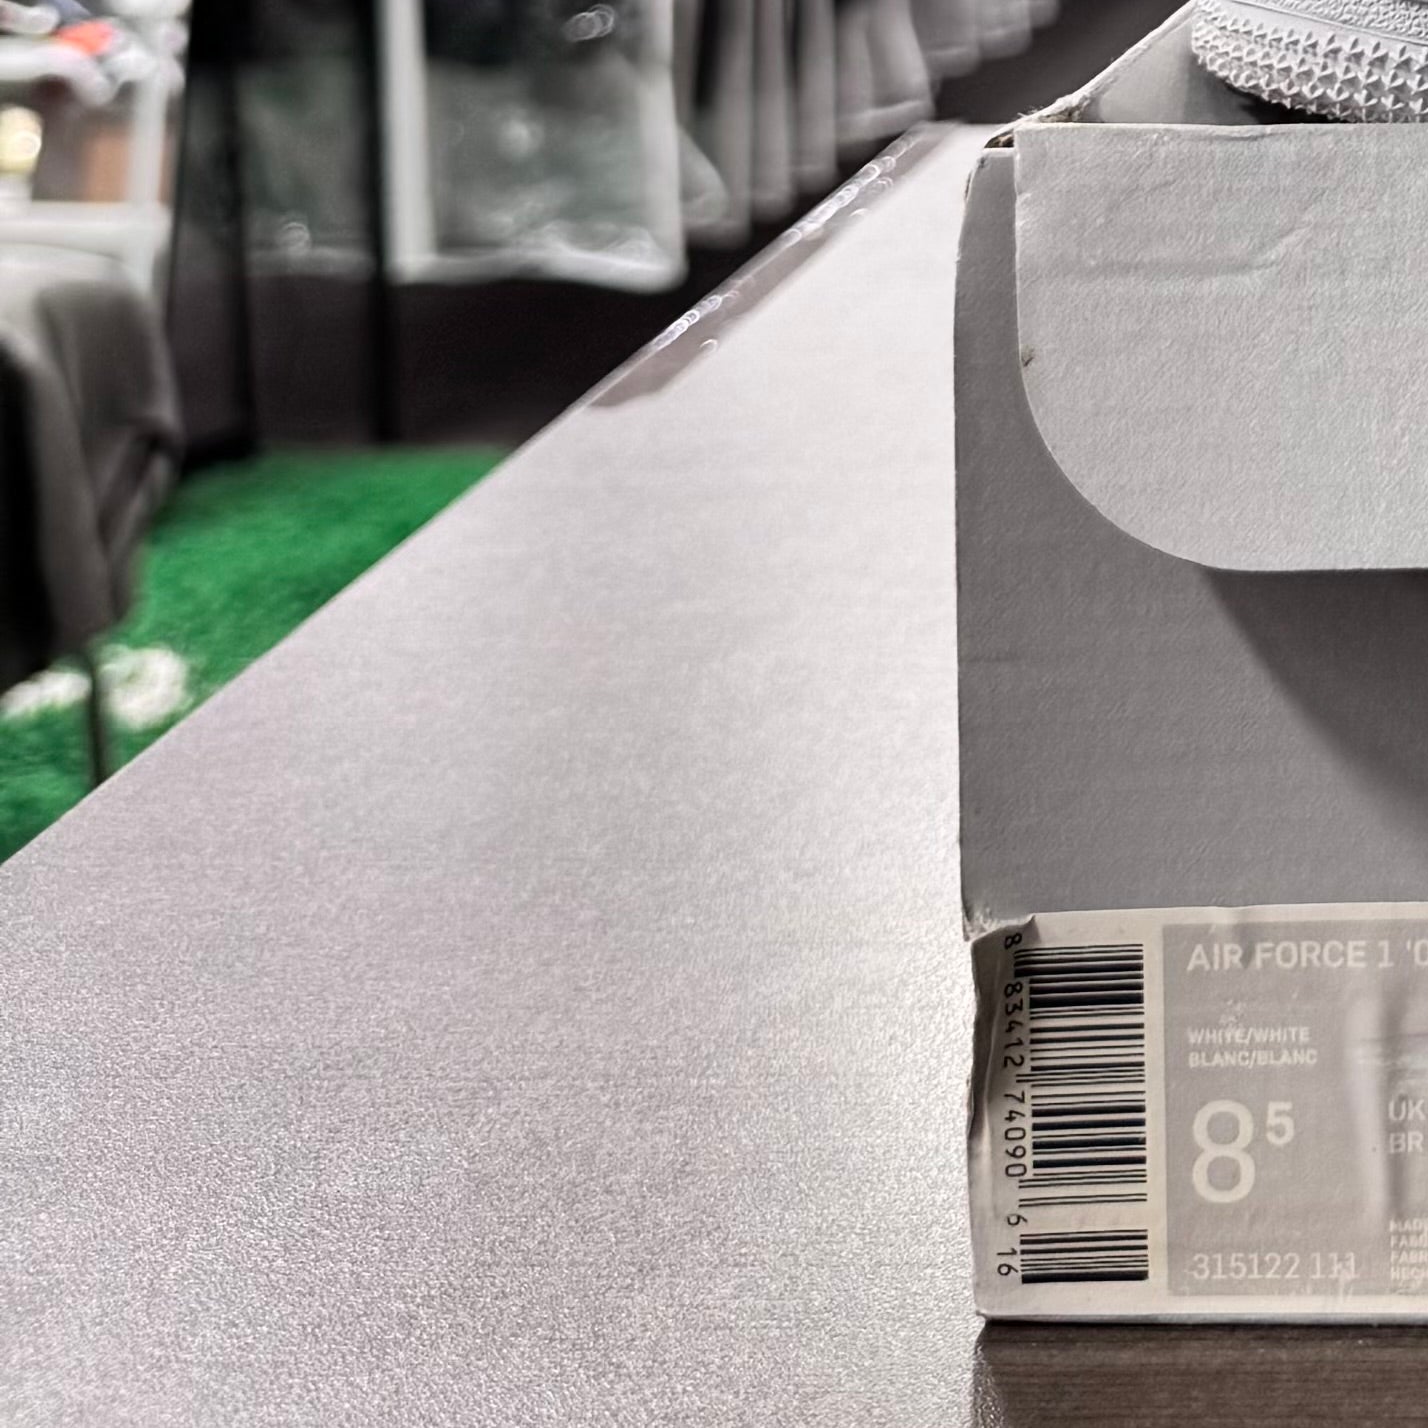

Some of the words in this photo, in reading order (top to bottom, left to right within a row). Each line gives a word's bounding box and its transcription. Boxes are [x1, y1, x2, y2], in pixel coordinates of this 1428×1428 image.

[1186, 942, 1243, 971] AIR
[1253, 940, 1368, 970] FORCE
[1377, 940, 1395, 967] 1
[1003, 981, 1025, 1069] 83412
[1186, 1026, 1312, 1045] WHITE/WHITE
[1188, 1049, 1318, 1069] BLANC/BLANC
[1388, 1098, 1426, 1122] UK
[1003, 1090, 1028, 1179] 74090
[1389, 1130, 1425, 1153] BR
[1191, 1251, 1301, 1281] 315122
